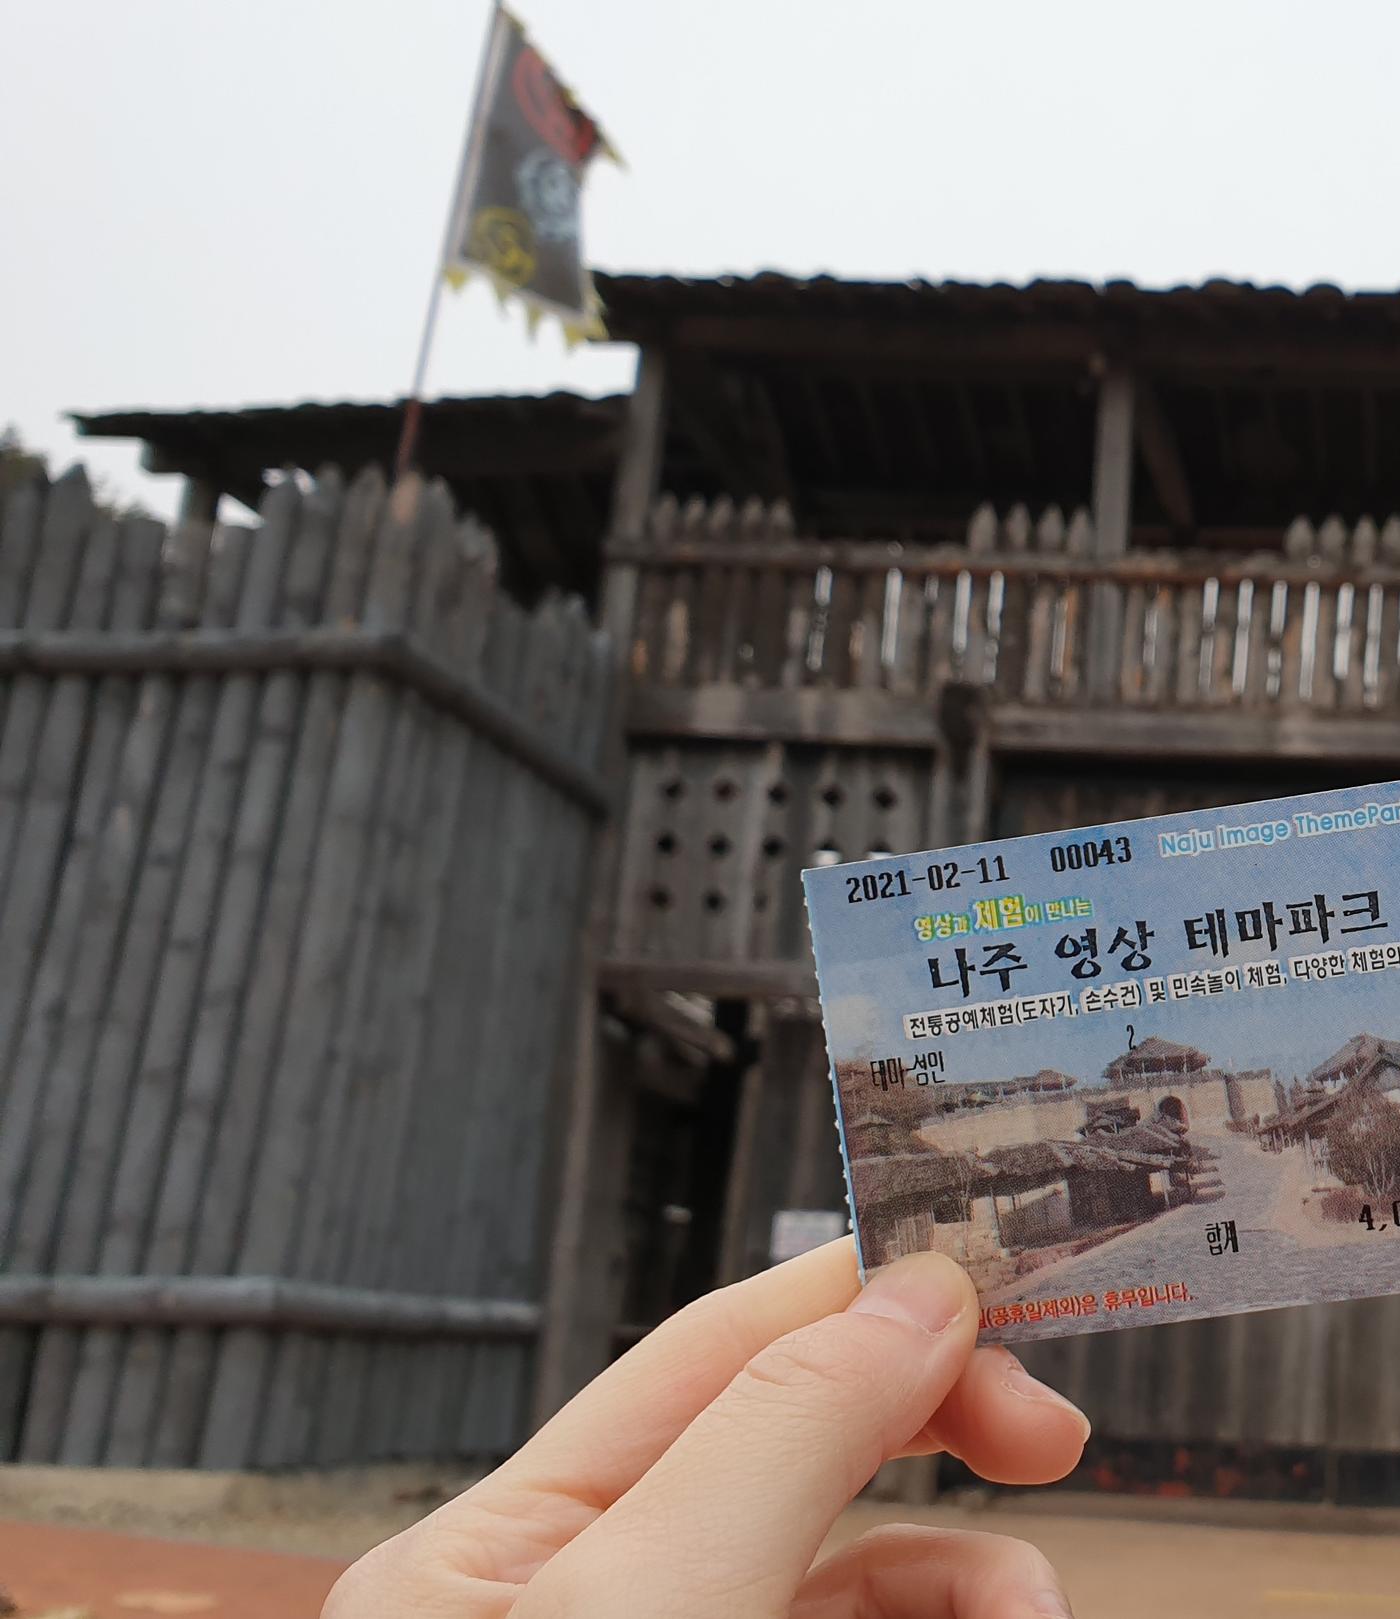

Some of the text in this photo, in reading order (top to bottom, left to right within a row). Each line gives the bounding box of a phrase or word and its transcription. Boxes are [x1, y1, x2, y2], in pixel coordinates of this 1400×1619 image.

[1160, 832, 1213, 857] Naju
[1219, 820, 1289, 846] Image
[845, 836, 1132, 904] 2021-02-11 00043
[914, 895, 1092, 940] 영상과 체험이 만나는
[927, 890, 1389, 998] 나주 영상 테마파크
[1086, 983, 1142, 1010] 손수건)
[1149, 981, 1166, 1002] 및
[1172, 969, 1241, 999] 민속놀이
[1247, 963, 1288, 988] 체험,
[1293, 953, 1345, 980] 다양한
[1205, 1219, 1239, 1256] 합계
